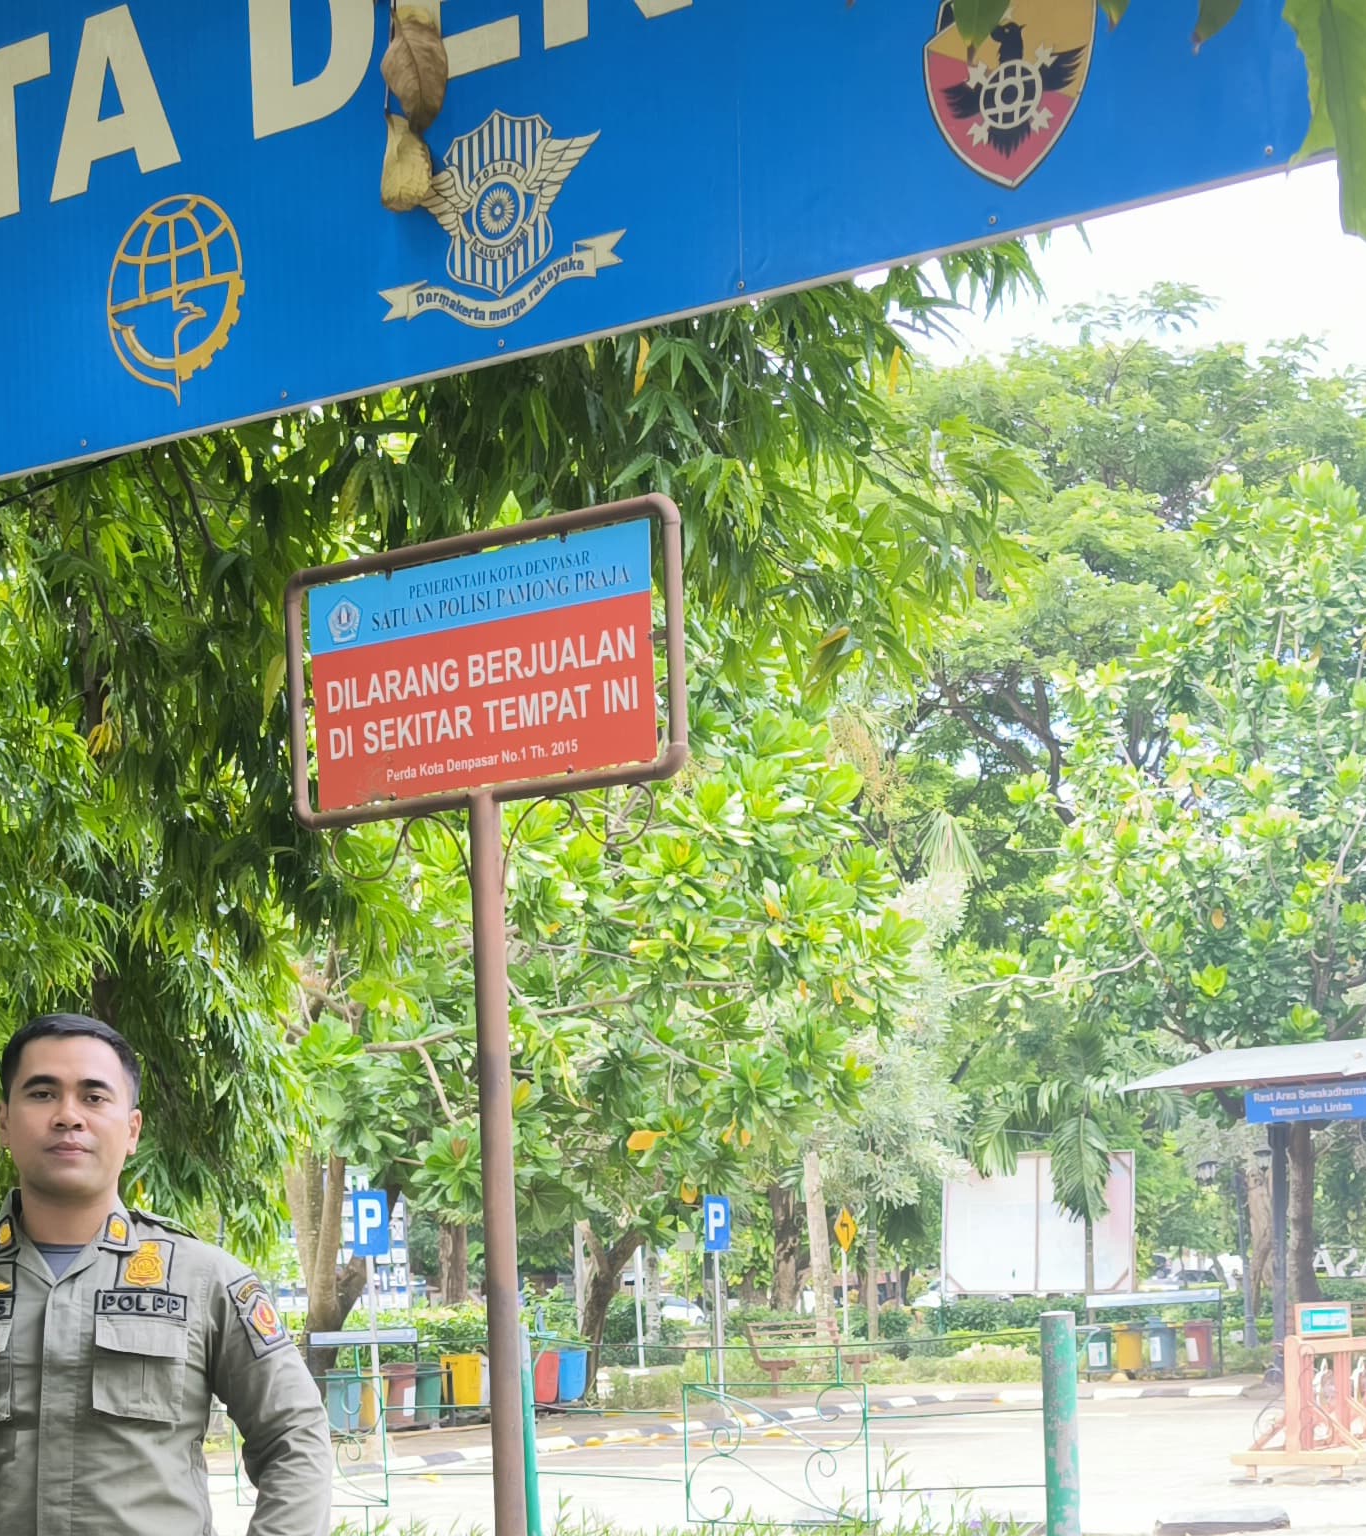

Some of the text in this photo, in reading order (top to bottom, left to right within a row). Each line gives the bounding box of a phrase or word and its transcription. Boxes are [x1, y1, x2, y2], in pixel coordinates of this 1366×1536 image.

[489, 297, 527, 320] marga
[371, 565, 630, 632] SATUAN POLISI PAMONG PRAJA
[408, 550, 590, 600] PEMERINTAH KOTA DENPASAR
[326, 625, 636, 714] DILARANG BERJUALAN
[329, 676, 639, 760] DI SEKITAR TEMPAT INI
[386, 739, 578, 783] Perda Kota Denpasar No.1 Th. 2015
[357, 1198, 382, 1245] P
[707, 1202, 725, 1241] P
[101, 1294, 181, 1314] POL PP
